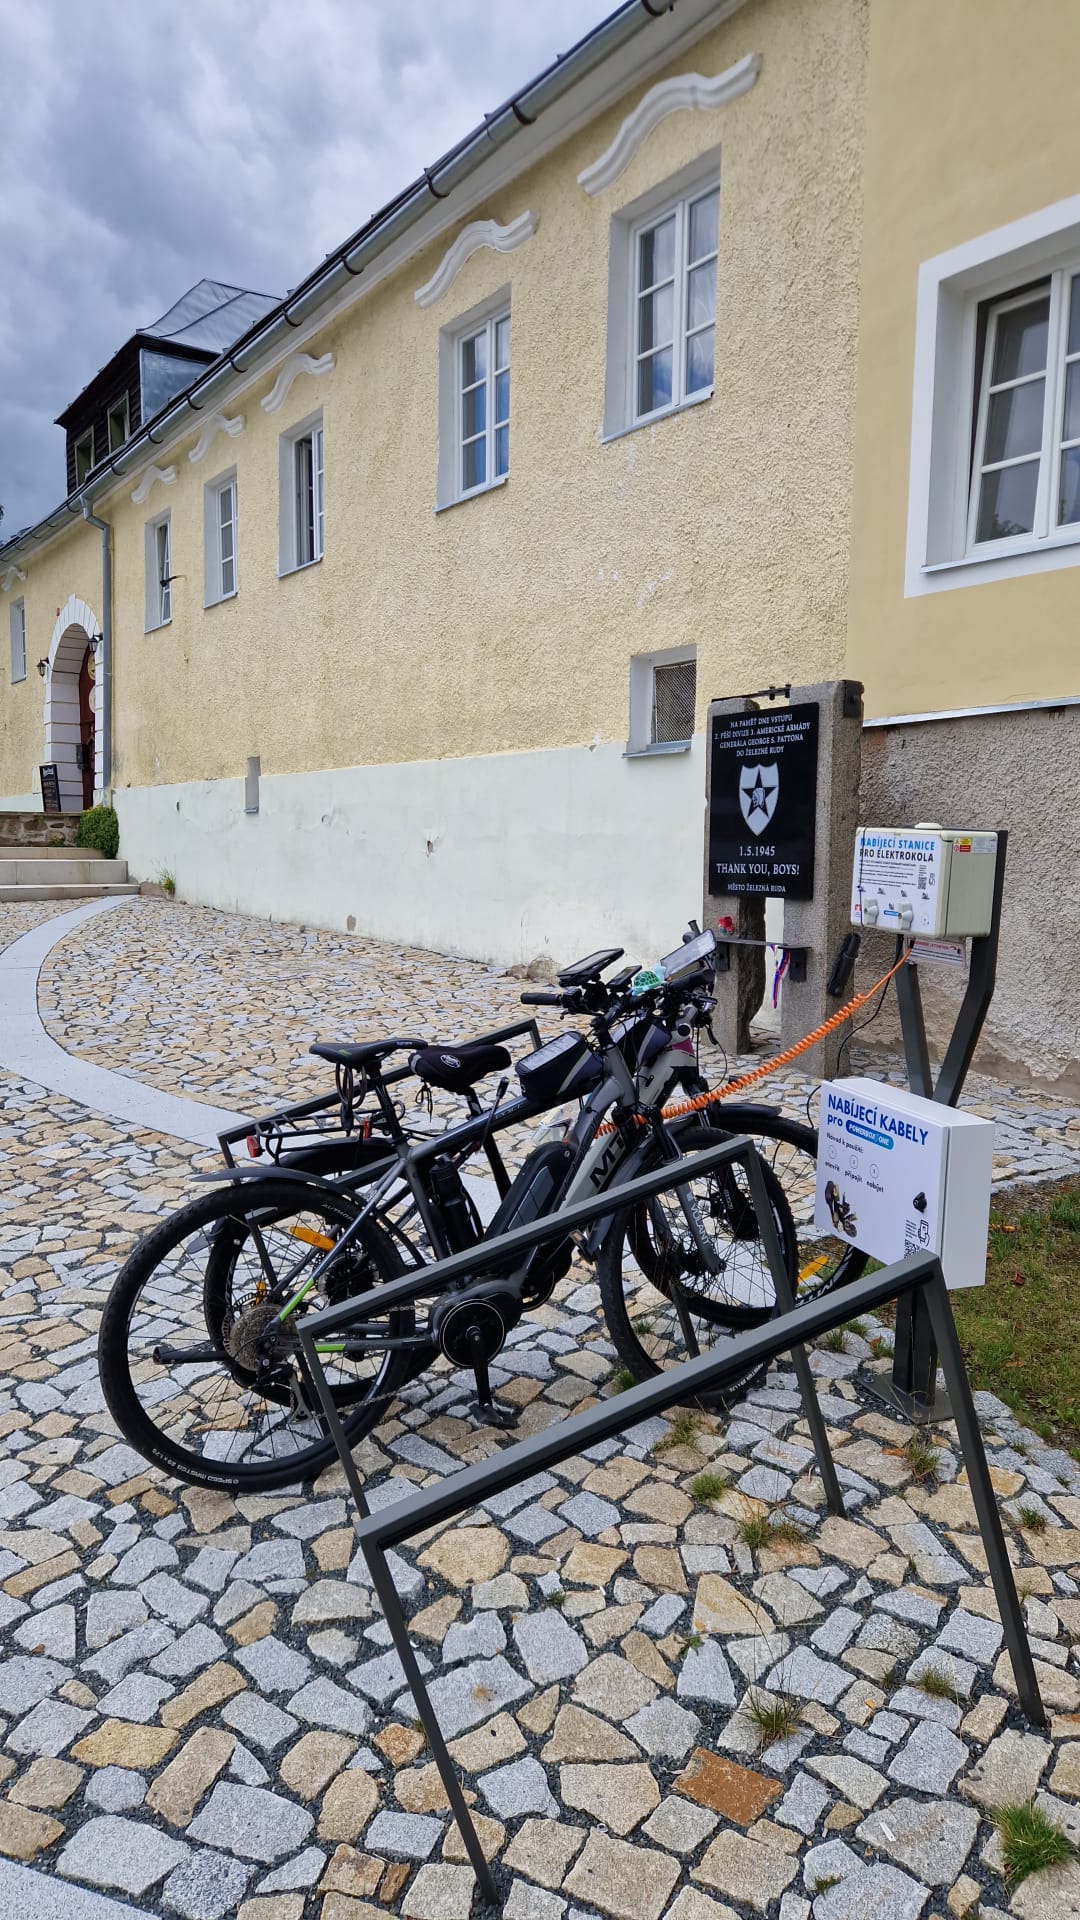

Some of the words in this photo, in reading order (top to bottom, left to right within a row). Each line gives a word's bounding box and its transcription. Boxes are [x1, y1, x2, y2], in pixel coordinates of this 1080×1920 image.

[730, 721, 738, 729] NA
[758, 716, 770, 725] DNE
[770, 713, 793, 723] VSTUPU
[732, 729, 749, 738] DIVIZE
[756, 725, 785, 735] AMERICKÉ
[786, 721, 811, 732] ARMÁDY
[720, 738, 747, 749] GENERÁLA
[747, 737, 770, 746] GEORGE
[770, 736, 776, 744] S.
[777, 734, 804, 743] PATTONA
[745, 746, 768, 756] ŽELEZNÉ
[769, 745, 785, 754] RUDY
[860, 836, 896, 850] NABÍJECÍ
[898, 839, 935, 851] STANICE
[739, 846, 776, 857] 1.5.1945
[859, 848, 875, 858] PRO
[877, 850, 934, 863] ELEKTROKOLA
[716, 863, 746, 874] THANK
[749, 863, 771, 877] YOU,
[773, 864, 800, 875] BOYS!
[727, 882, 745, 891] MĚSTO
[746, 882, 769, 892] ŽELEZNÁ
[770, 885, 786, 893] RUDA
[828, 1093, 878, 1126] NABÍJECÍ
[879, 1114, 929, 1146] KABELY
[827, 1113, 843, 1127] pro
[878, 1136, 890, 1146] ONE
[691, 1203, 710, 1246] VOLANT
